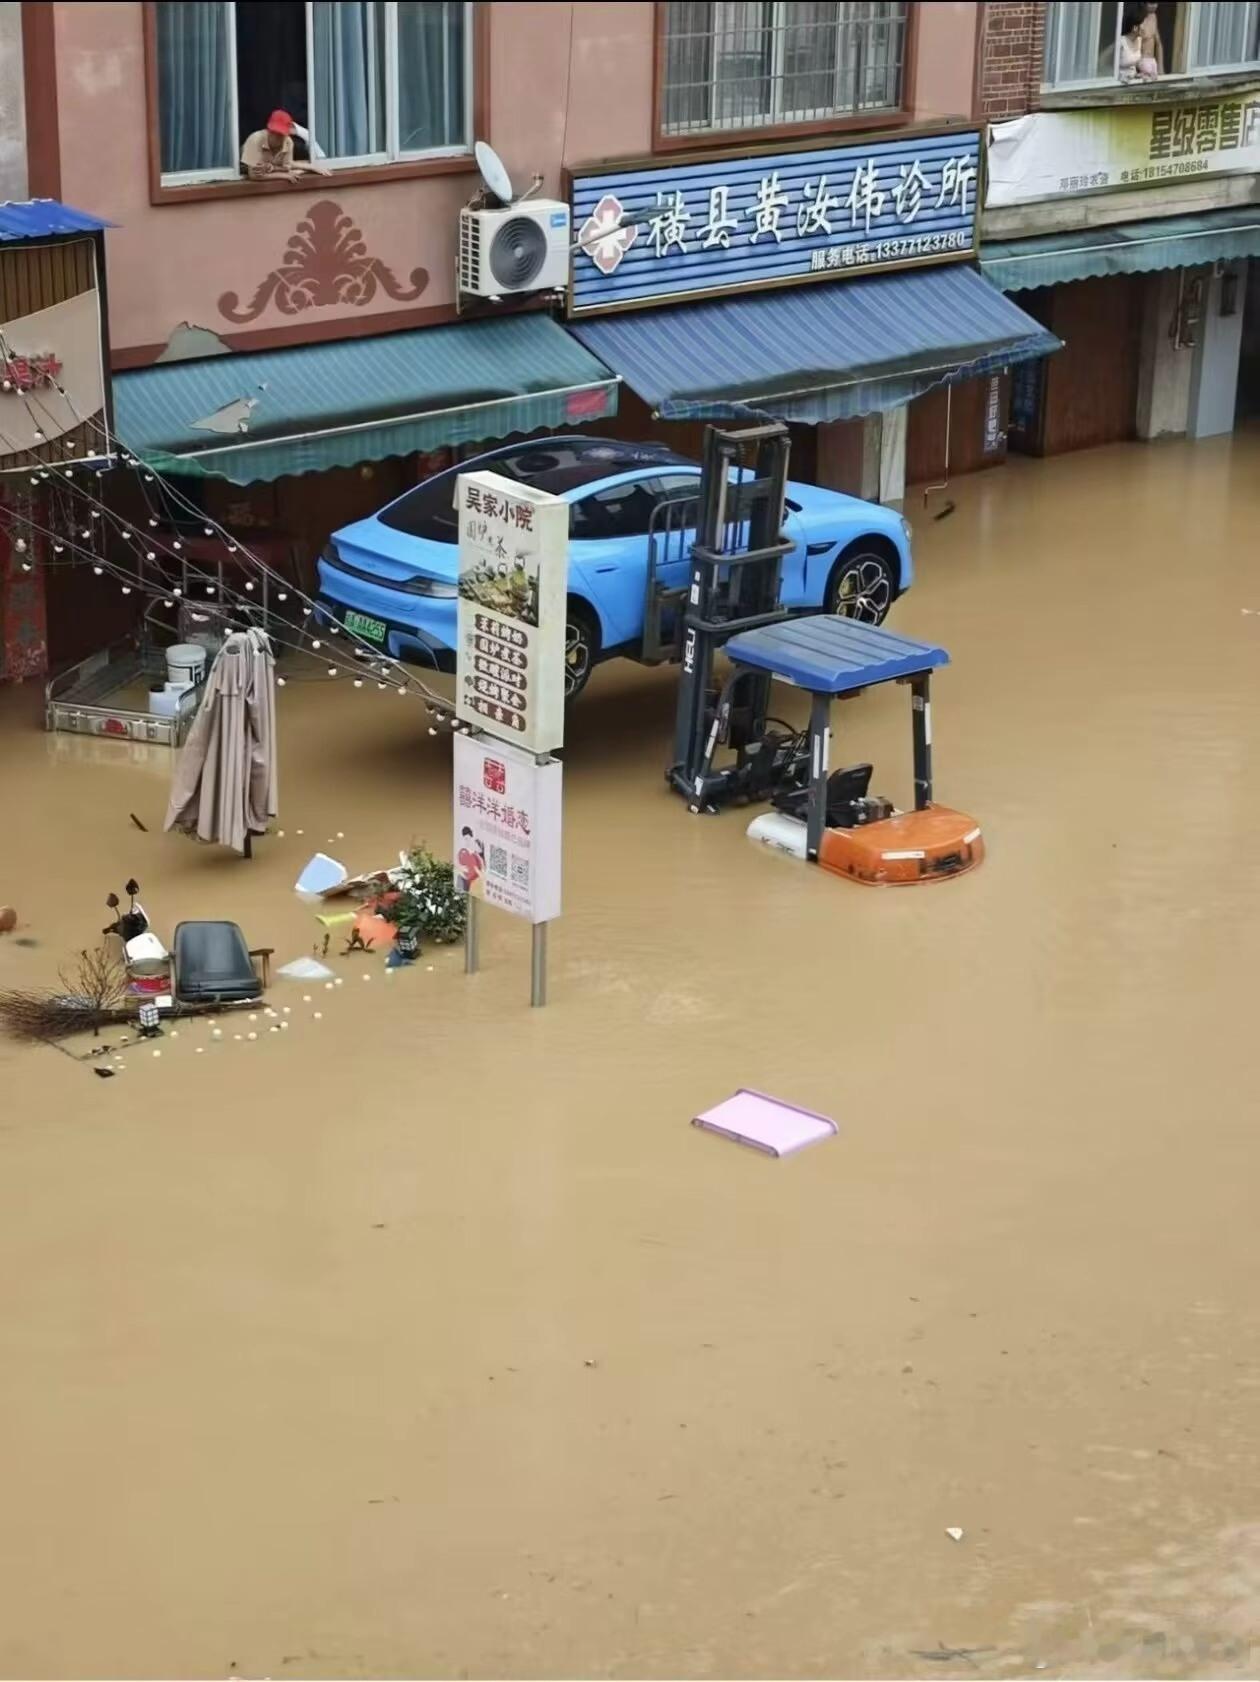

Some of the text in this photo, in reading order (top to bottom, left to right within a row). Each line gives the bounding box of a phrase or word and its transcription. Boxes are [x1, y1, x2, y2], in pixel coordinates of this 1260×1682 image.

[647, 153, 978, 258] 横县黄汝伟诊所
[811, 231, 965, 270] 服务电话:13377123780
[465, 487, 534, 531] 吴家小院
[684, 628, 696, 674] HELI
